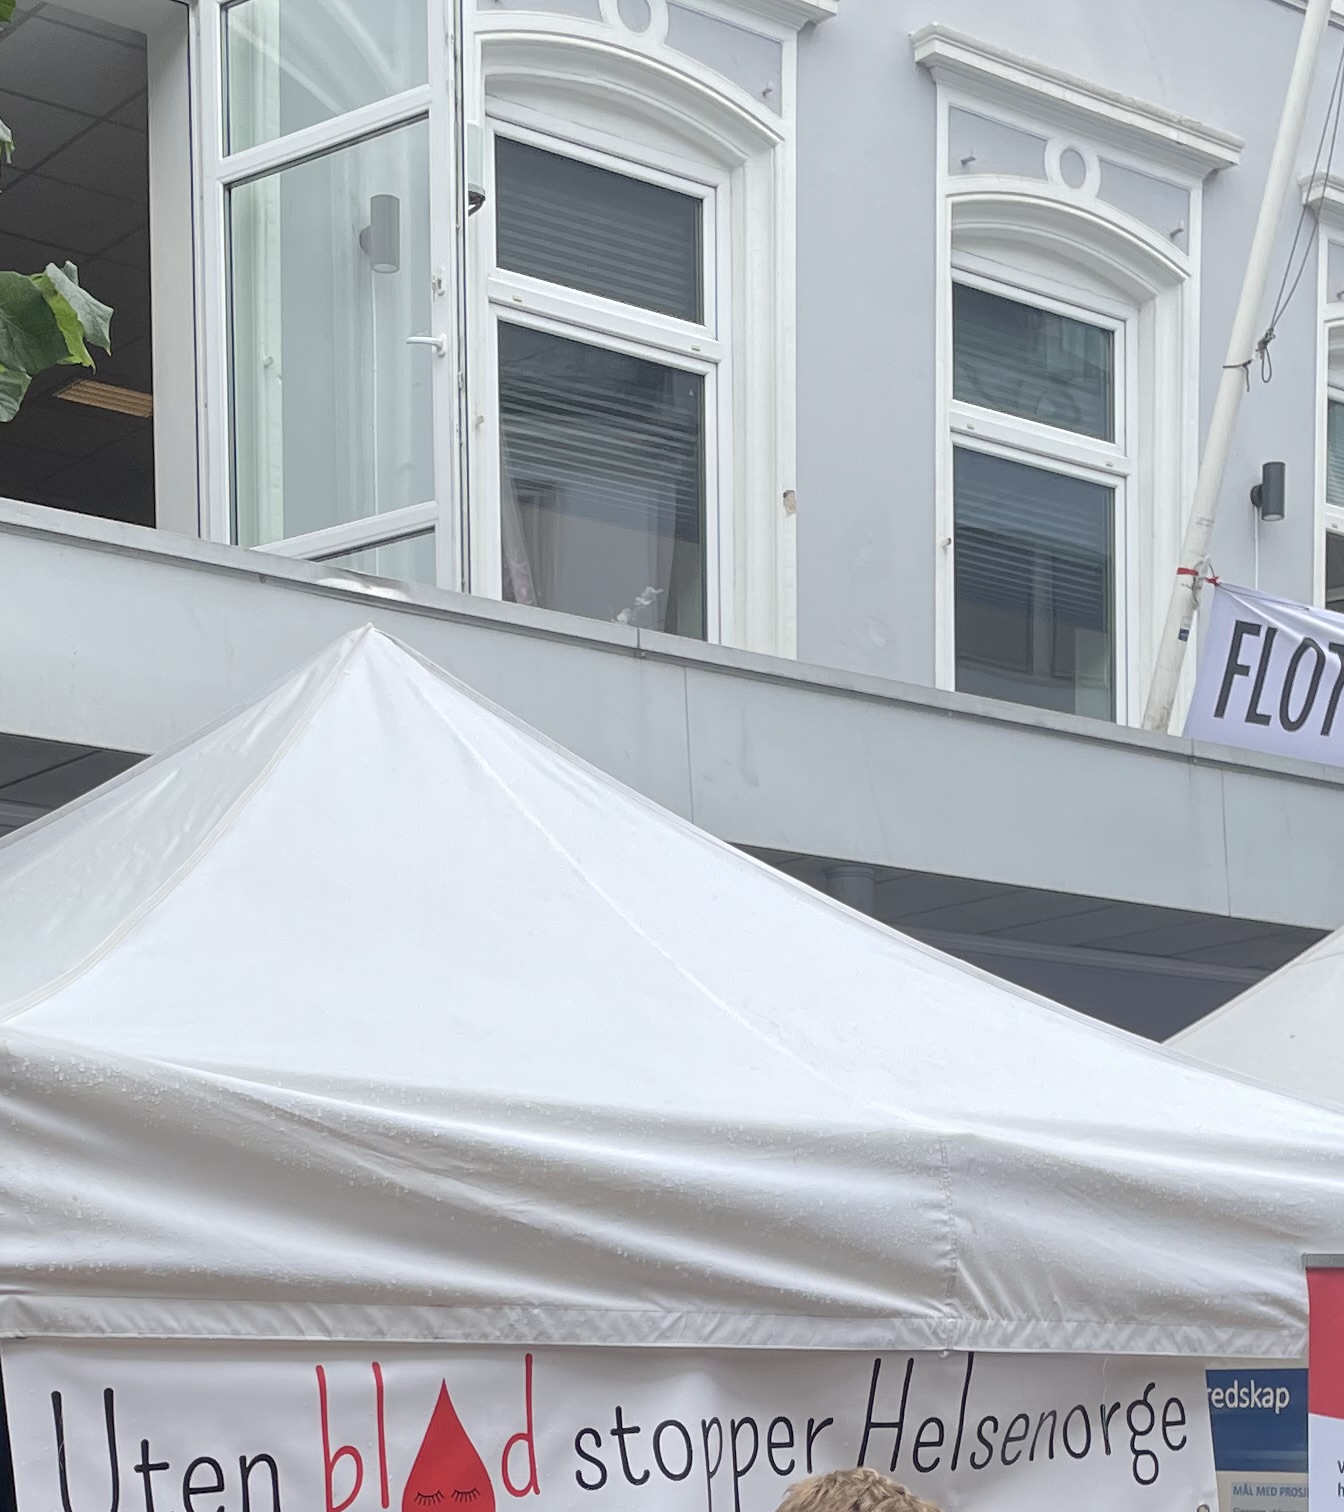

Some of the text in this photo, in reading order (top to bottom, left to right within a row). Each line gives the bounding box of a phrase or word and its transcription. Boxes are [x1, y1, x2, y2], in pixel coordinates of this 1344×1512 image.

[857, 1351, 1189, 1486] Helsenorge
[1233, 1484, 1253, 1496] MÅL
[1256, 1485, 1277, 1496] MED
